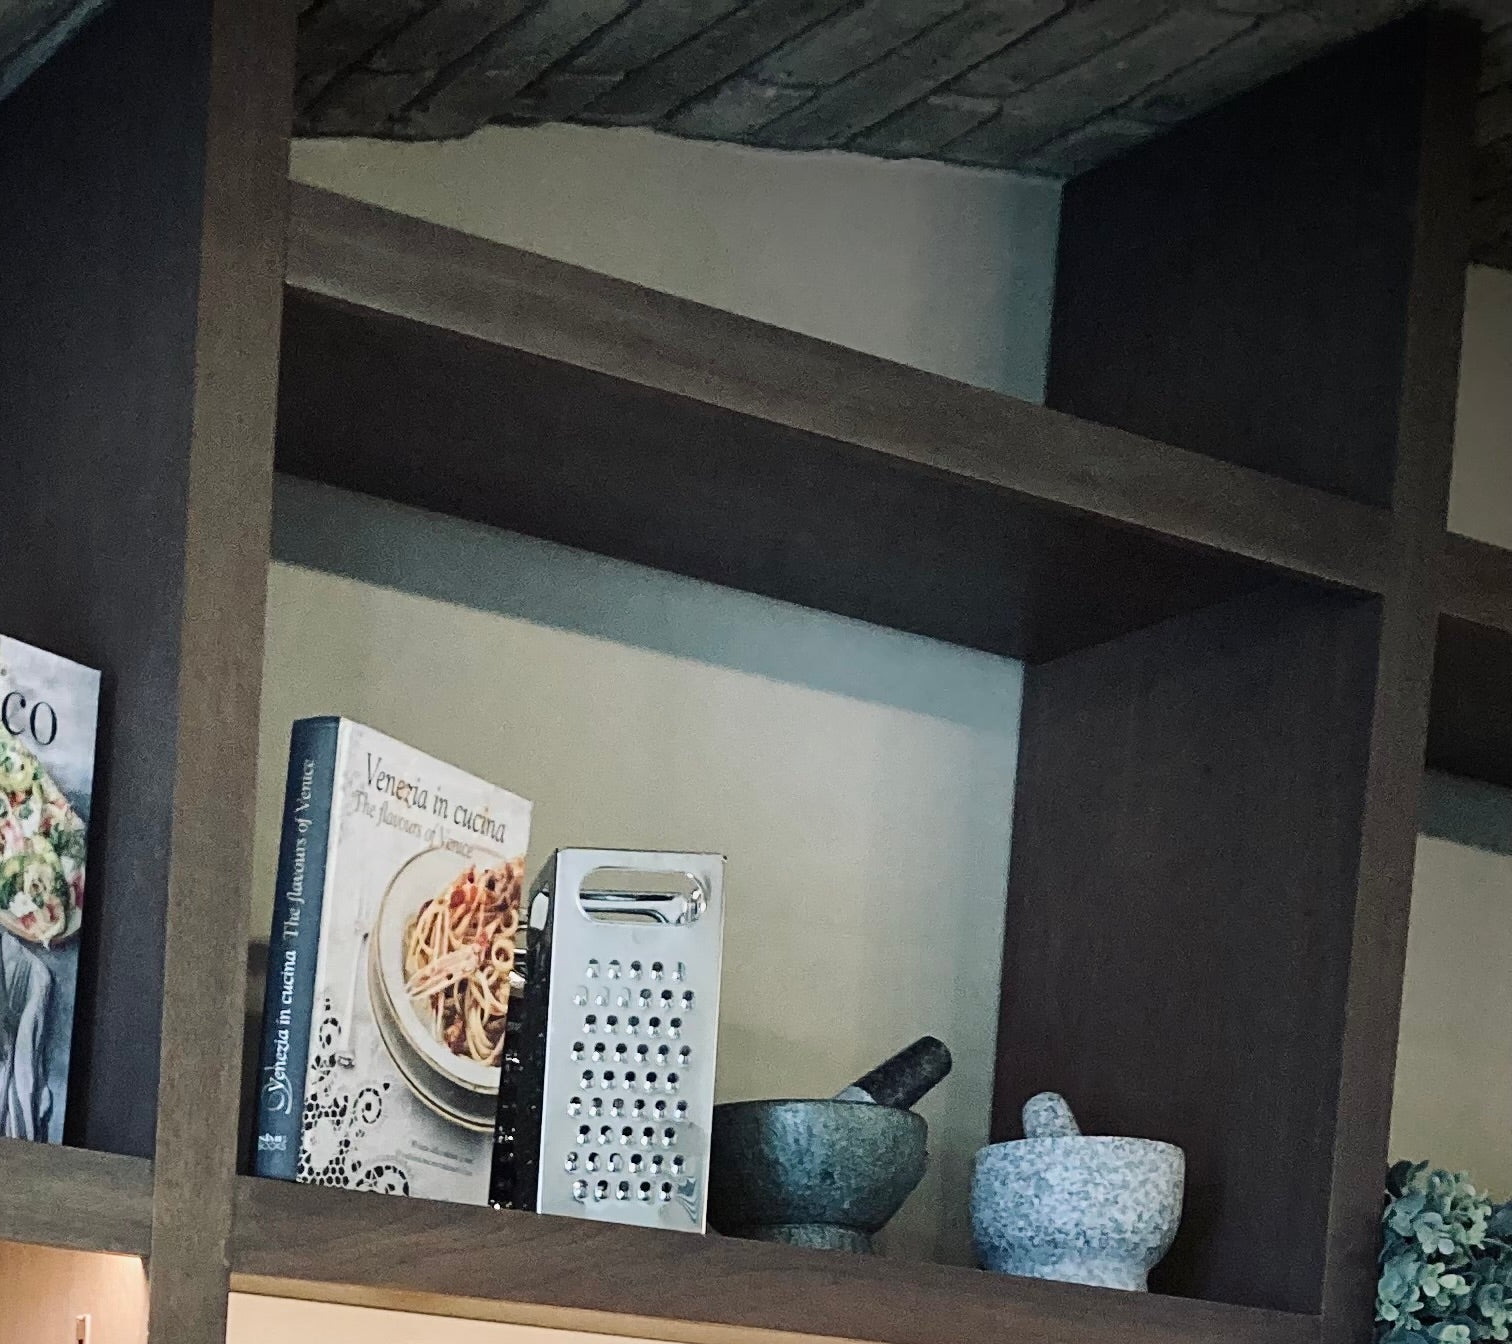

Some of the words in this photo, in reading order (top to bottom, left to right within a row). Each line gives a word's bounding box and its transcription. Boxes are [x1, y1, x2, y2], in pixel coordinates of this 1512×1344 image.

[367, 752, 430, 810] Venezia
[432, 785, 449, 819] in
[454, 804, 507, 844] cucina
[286, 837, 308, 904] flavours
[283, 905, 301, 941] The
[281, 949, 297, 1005] cucina
